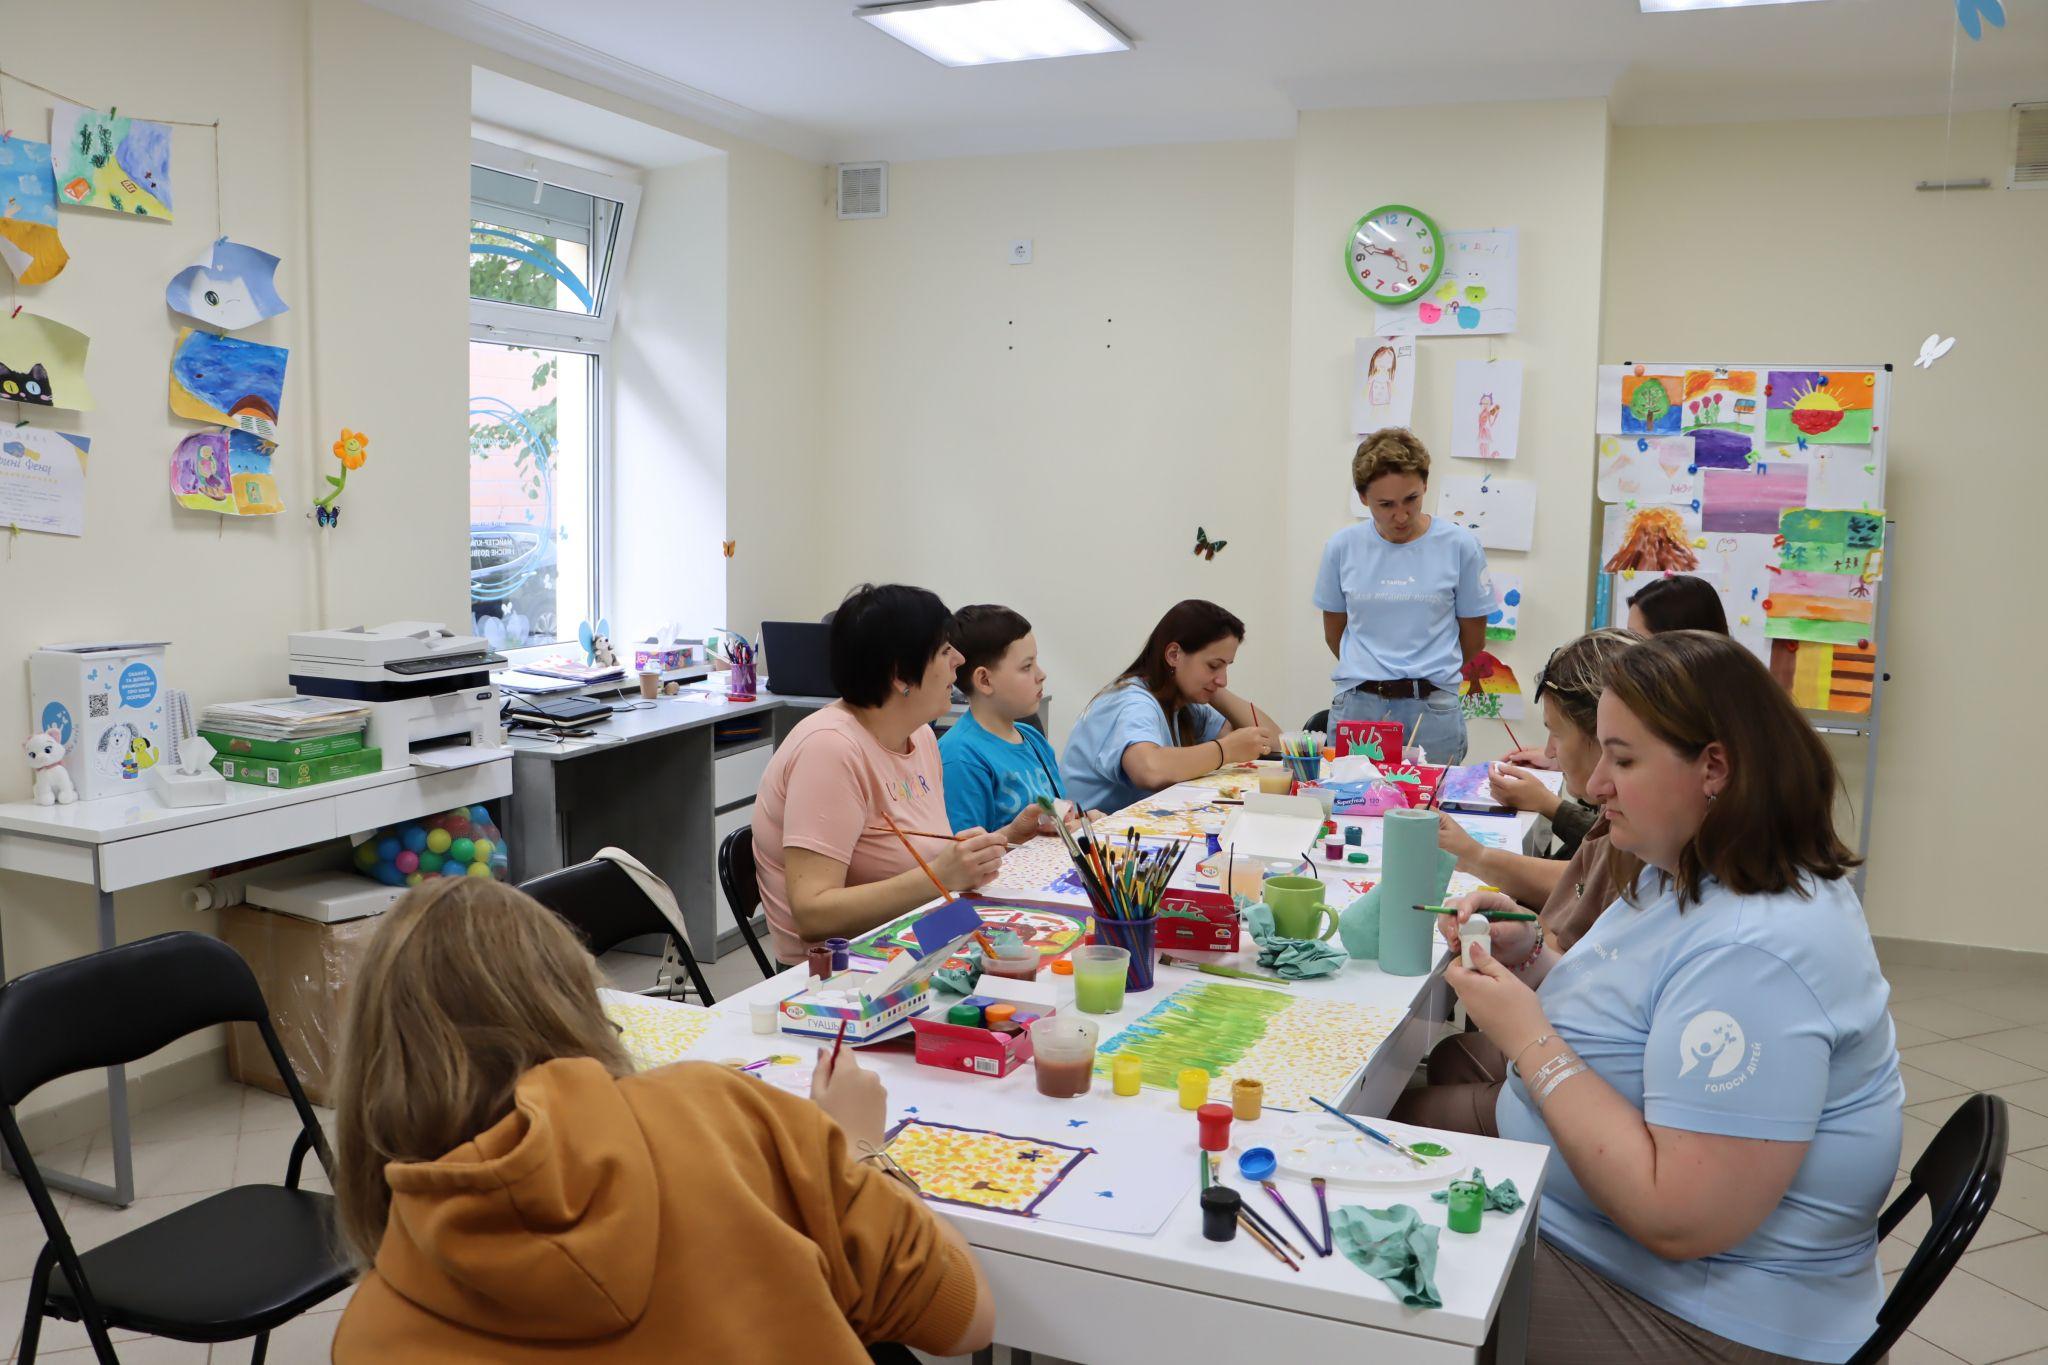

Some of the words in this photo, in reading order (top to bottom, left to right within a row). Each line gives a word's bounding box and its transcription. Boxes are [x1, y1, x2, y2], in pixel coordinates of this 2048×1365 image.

[1385, 214, 1398, 225] 12
[1416, 228, 1427, 239] 2
[1422, 246, 1433, 255] 3
[1355, 253, 1366, 262] 9
[1418, 263, 1430, 272] 4
[1360, 269, 1371, 279] 8
[1375, 279, 1385, 289] 7
[1407, 275, 1417, 286] 5
[1391, 282, 1400, 293] 6
